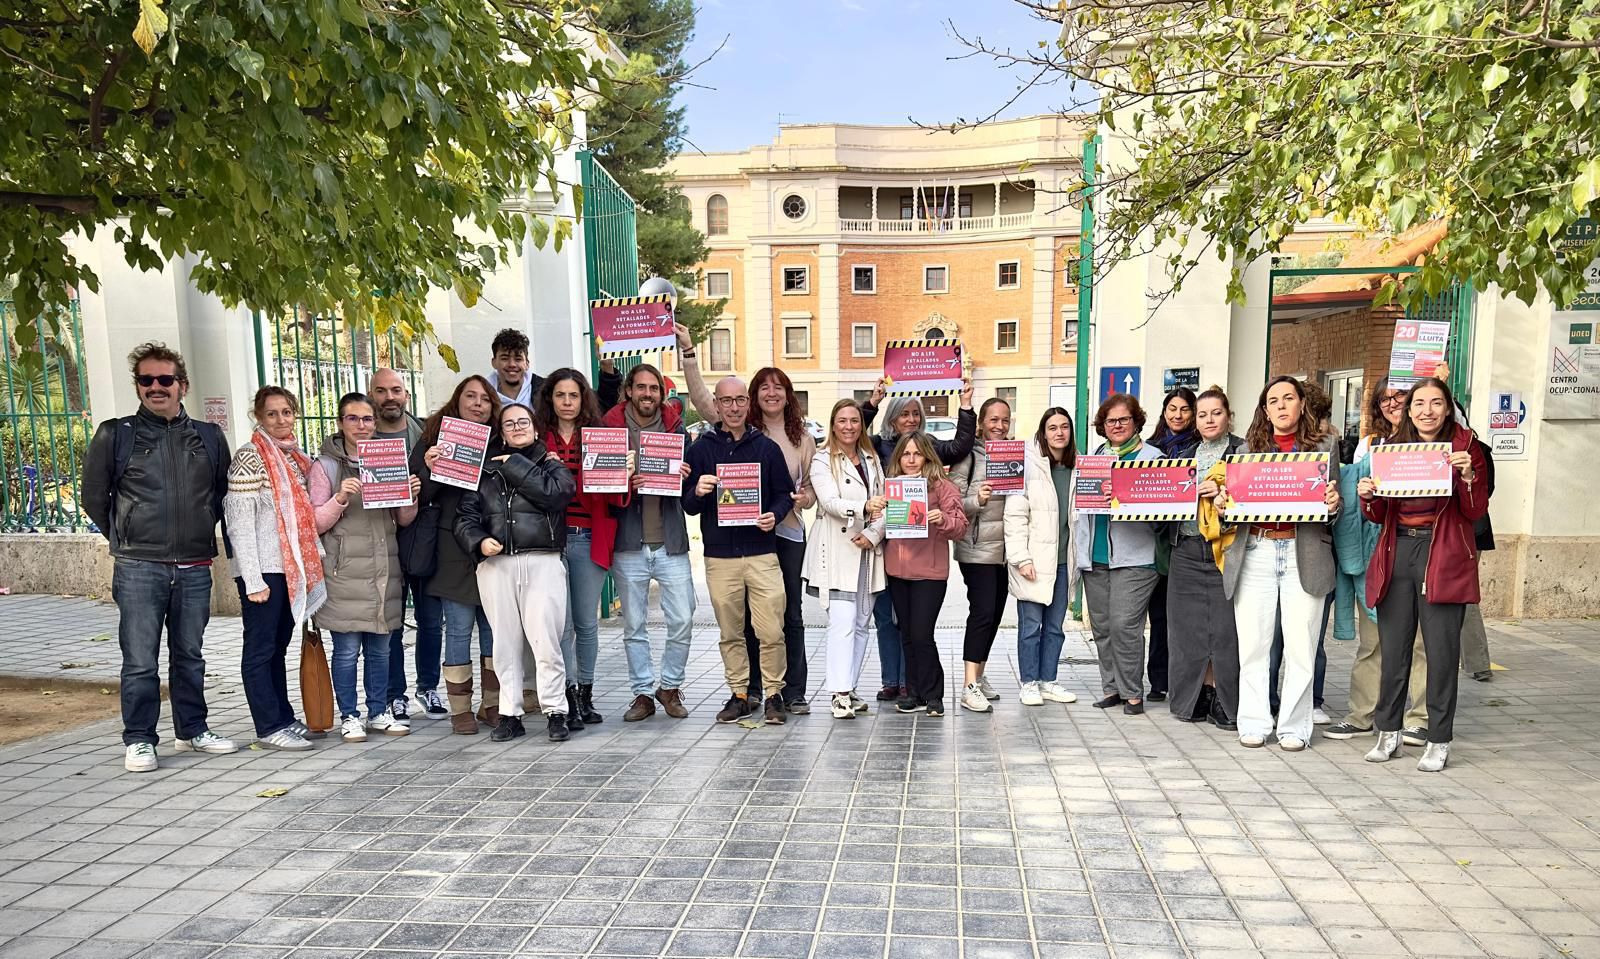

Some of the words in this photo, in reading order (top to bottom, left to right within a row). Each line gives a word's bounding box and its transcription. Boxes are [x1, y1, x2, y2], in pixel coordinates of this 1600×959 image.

[1397, 327, 1416, 337] 20
[444, 420, 451, 428] 7
[584, 432, 591, 440] 7
[642, 434, 649, 443] 7
[359, 444, 366, 453] 7
[888, 485, 900, 497] 11
